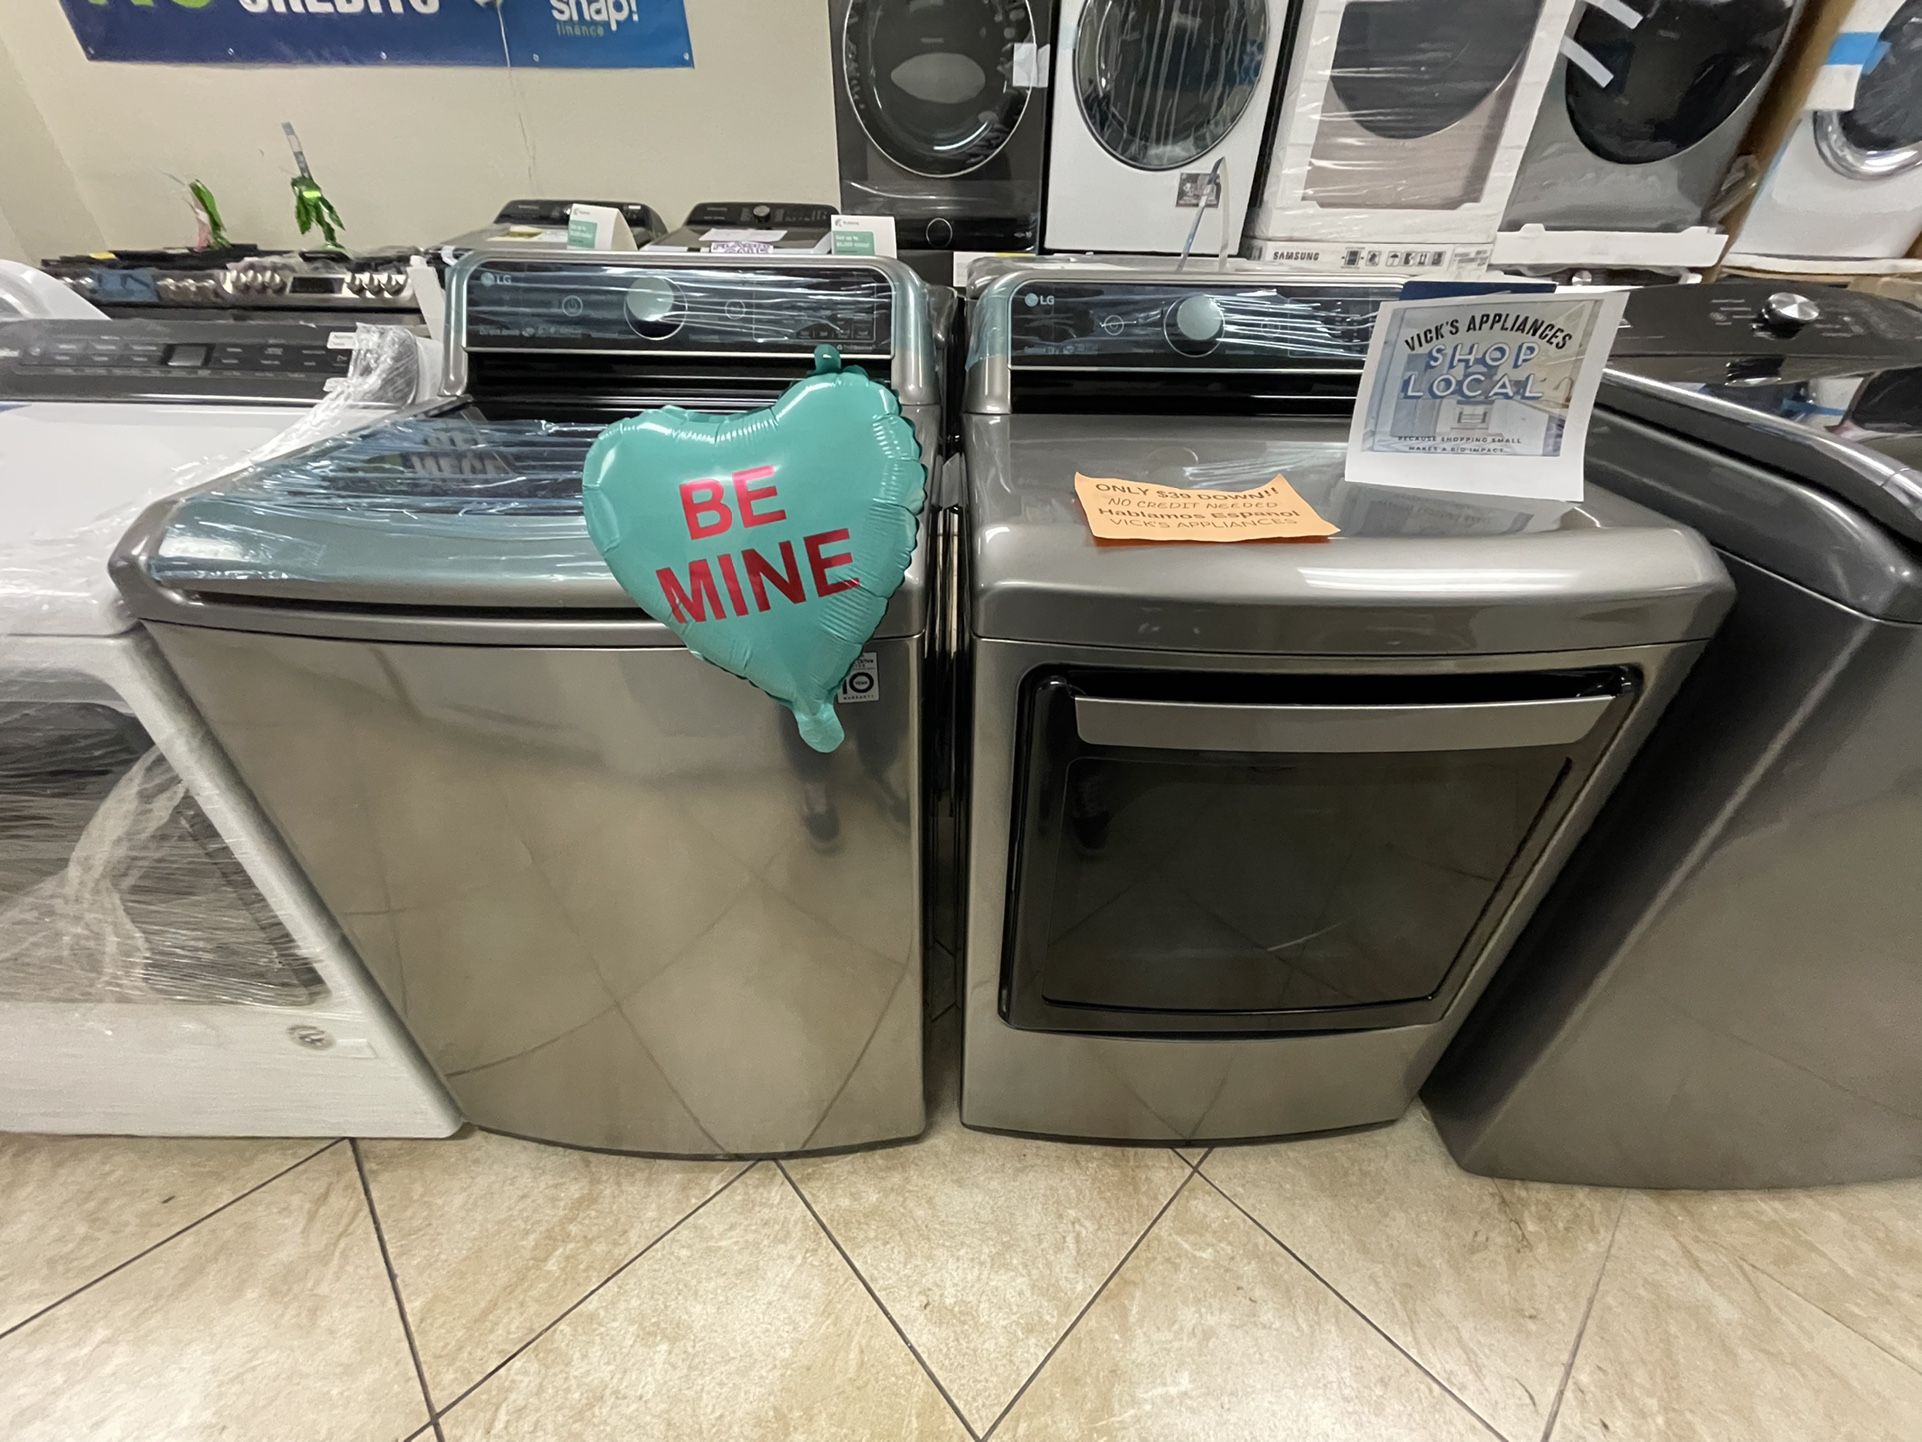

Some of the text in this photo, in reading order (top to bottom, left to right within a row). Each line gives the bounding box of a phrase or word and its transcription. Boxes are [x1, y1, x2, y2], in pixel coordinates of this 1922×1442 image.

[549, 0, 639, 31] snap!
[1272, 250, 1320, 262] SAMSUNG
[496, 274, 512, 285] LG
[1039, 295, 1055, 305] LG
[1404, 313, 1573, 352] VICK'S APPLIANCES
[1428, 342, 1540, 369] SHOP
[1402, 373, 1544, 399] LOCAL
[1095, 483, 1149, 496] ONLY
[1197, 486, 1279, 501] DOWN!!
[679, 465, 787, 541] BE
[1107, 497, 1279, 510] NO CREDIT NEEDED
[1098, 508, 1206, 520] Hablamos
[1109, 518, 1298, 529] VICK'S APPLIANCES
[655, 528, 860, 624] MINE
